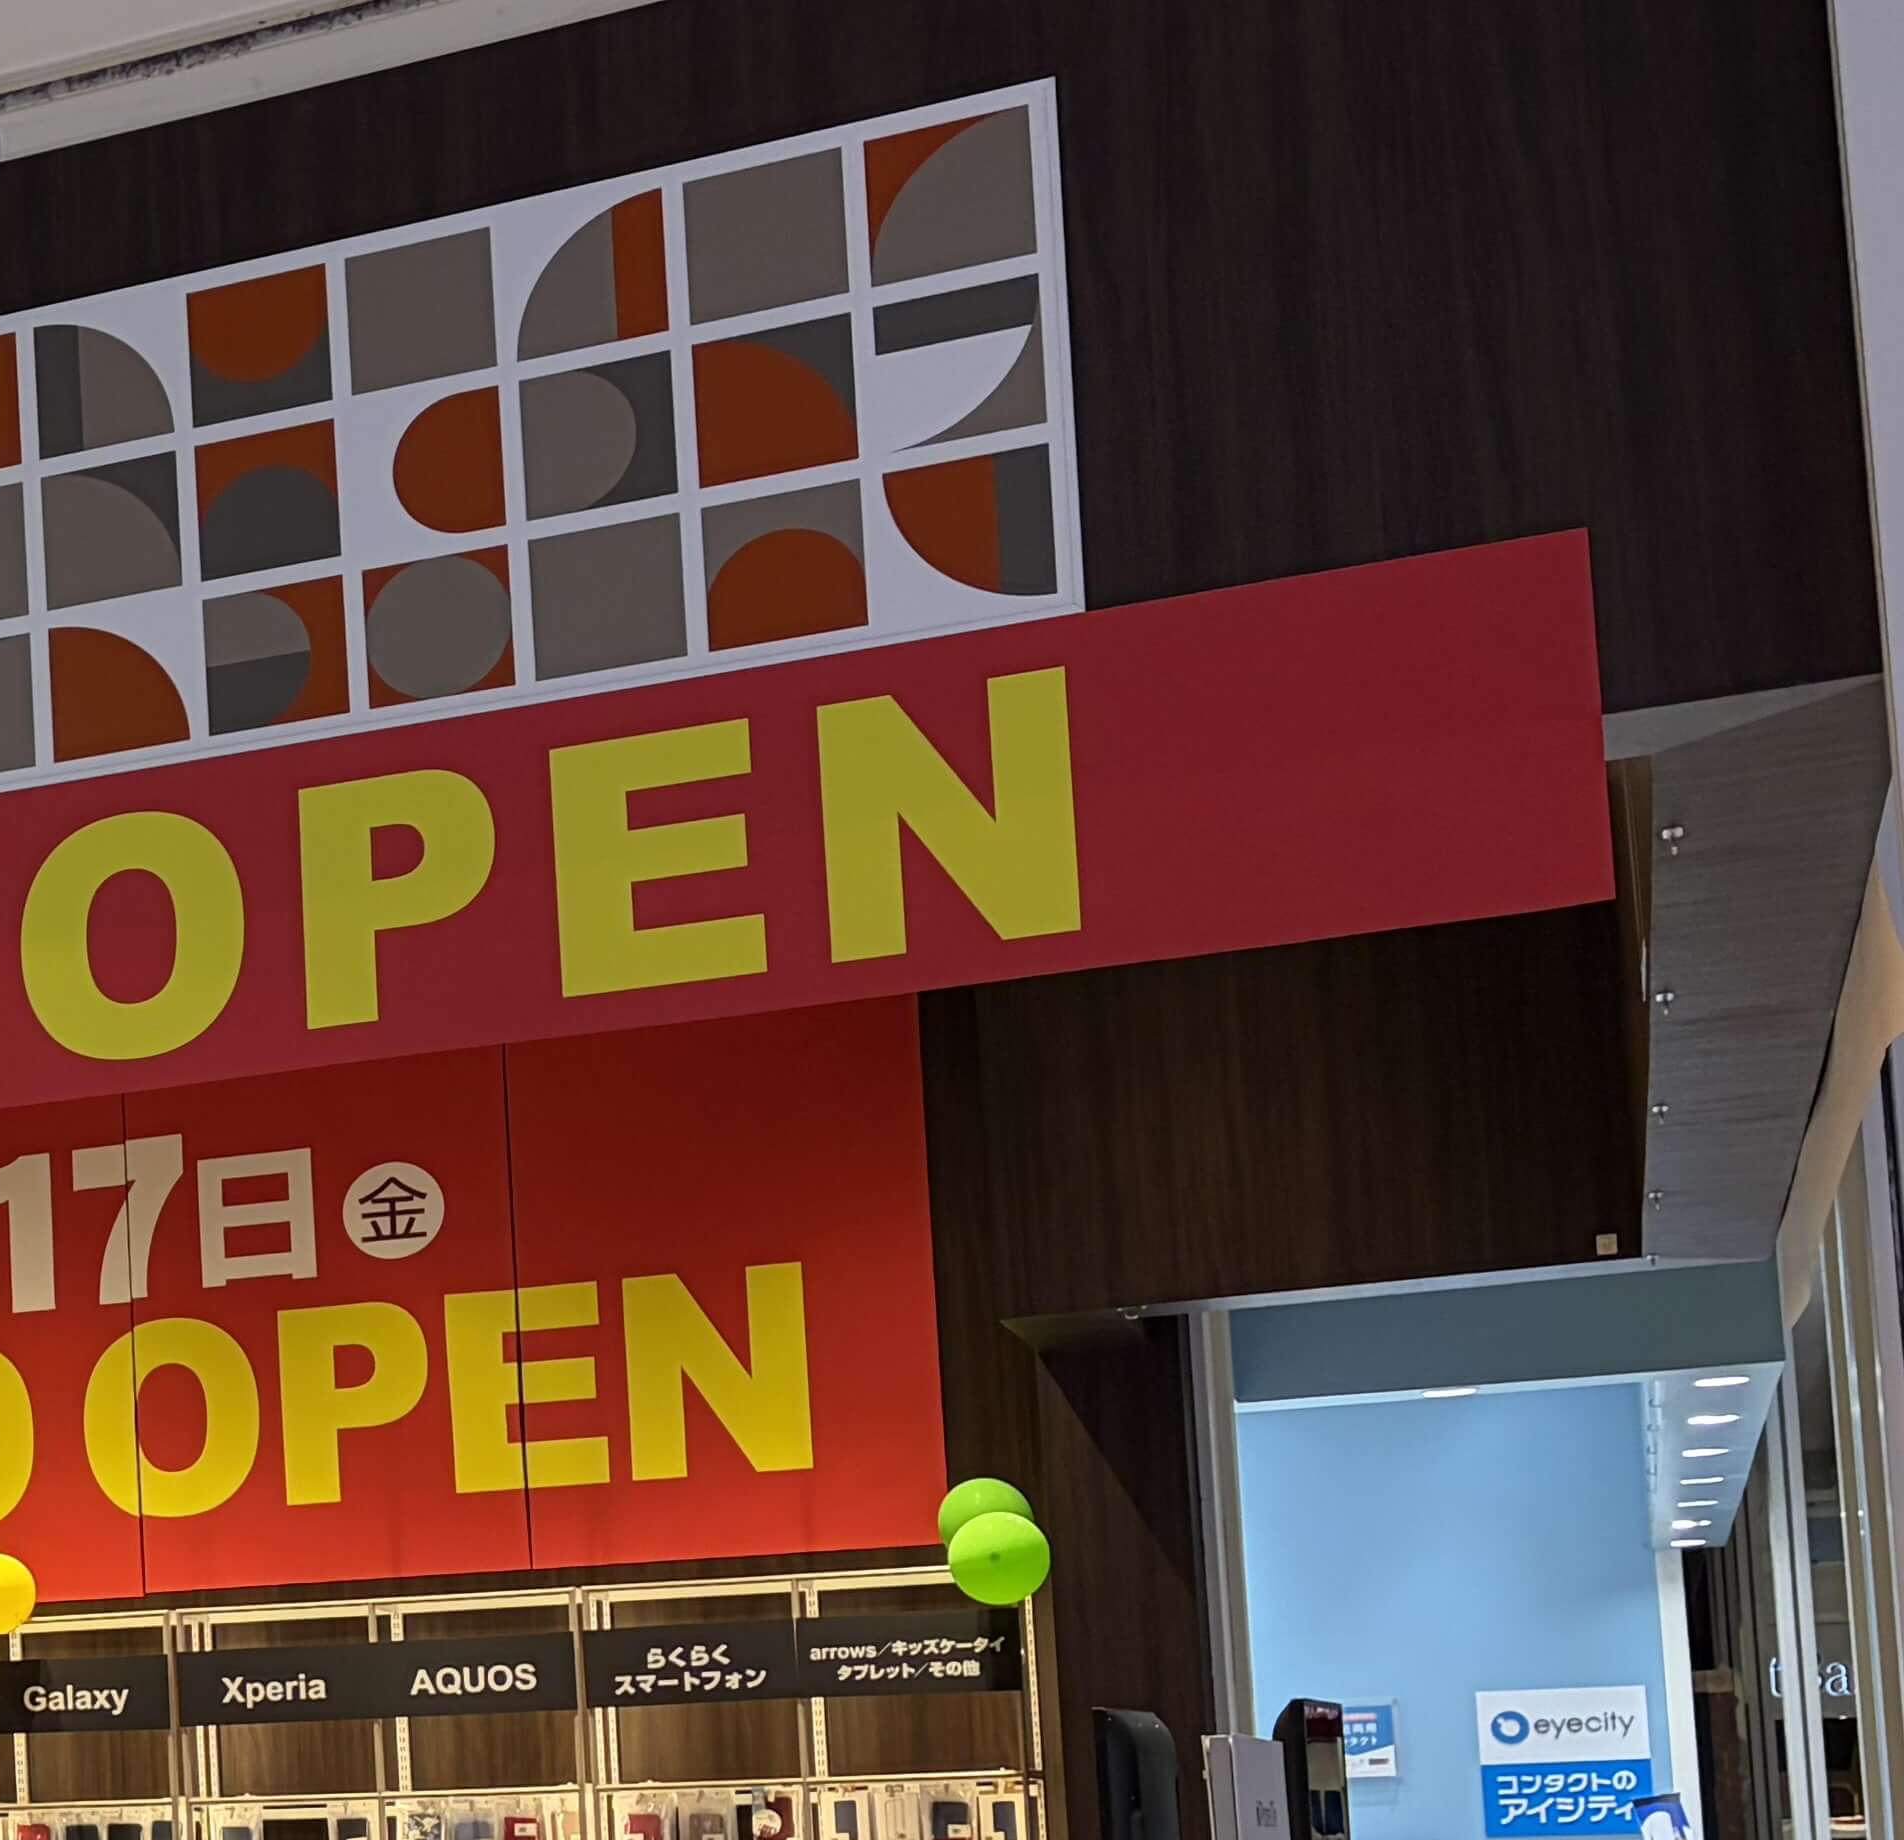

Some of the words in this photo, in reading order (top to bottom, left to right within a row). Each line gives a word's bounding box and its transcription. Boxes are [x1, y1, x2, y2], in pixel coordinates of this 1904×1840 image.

[20, 667, 1083, 1060] OPEN
[83, 1260, 815, 1519] OPEN
[646, 1643, 732, 1670] らくらく
[222, 1674, 327, 1705] Xperia
[410, 1663, 537, 1697] AQUOS
[614, 1667, 767, 1697] スマートフォン
[23, 1686, 129, 1716] Galaxy
[1533, 1712, 1634, 1739] eyecity
[1496, 1770, 1637, 1796] コンタクトの
[1499, 1797, 1633, 1825] アイシティ
